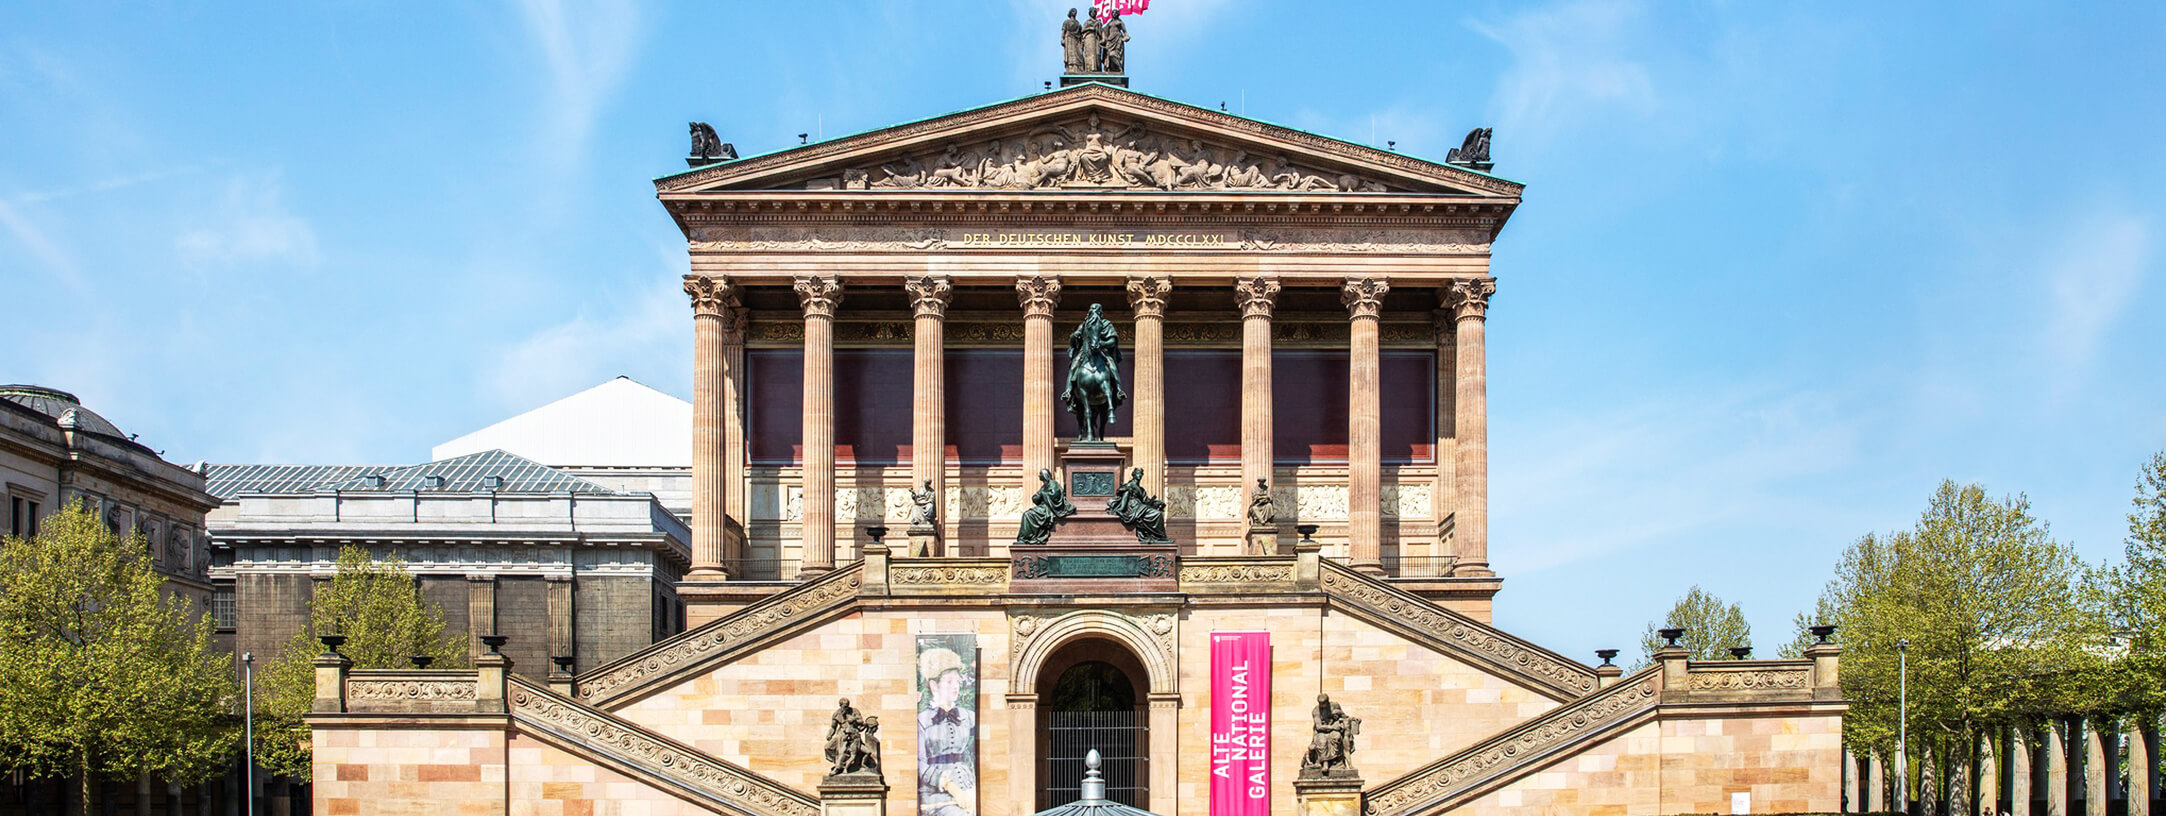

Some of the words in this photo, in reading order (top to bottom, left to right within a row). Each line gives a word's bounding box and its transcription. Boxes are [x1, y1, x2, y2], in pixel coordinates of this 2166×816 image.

[963, 233, 991, 245] DER
[999, 233, 1081, 245] DEUTSCHEN
[1089, 233, 1134, 245] KUNST
[1146, 233, 1224, 245] MDCCCLXXI
[1231, 660, 1248, 760] NATIONAL
[1213, 733, 1230, 778] ALTE
[1248, 712, 1266, 799] GALERIE
